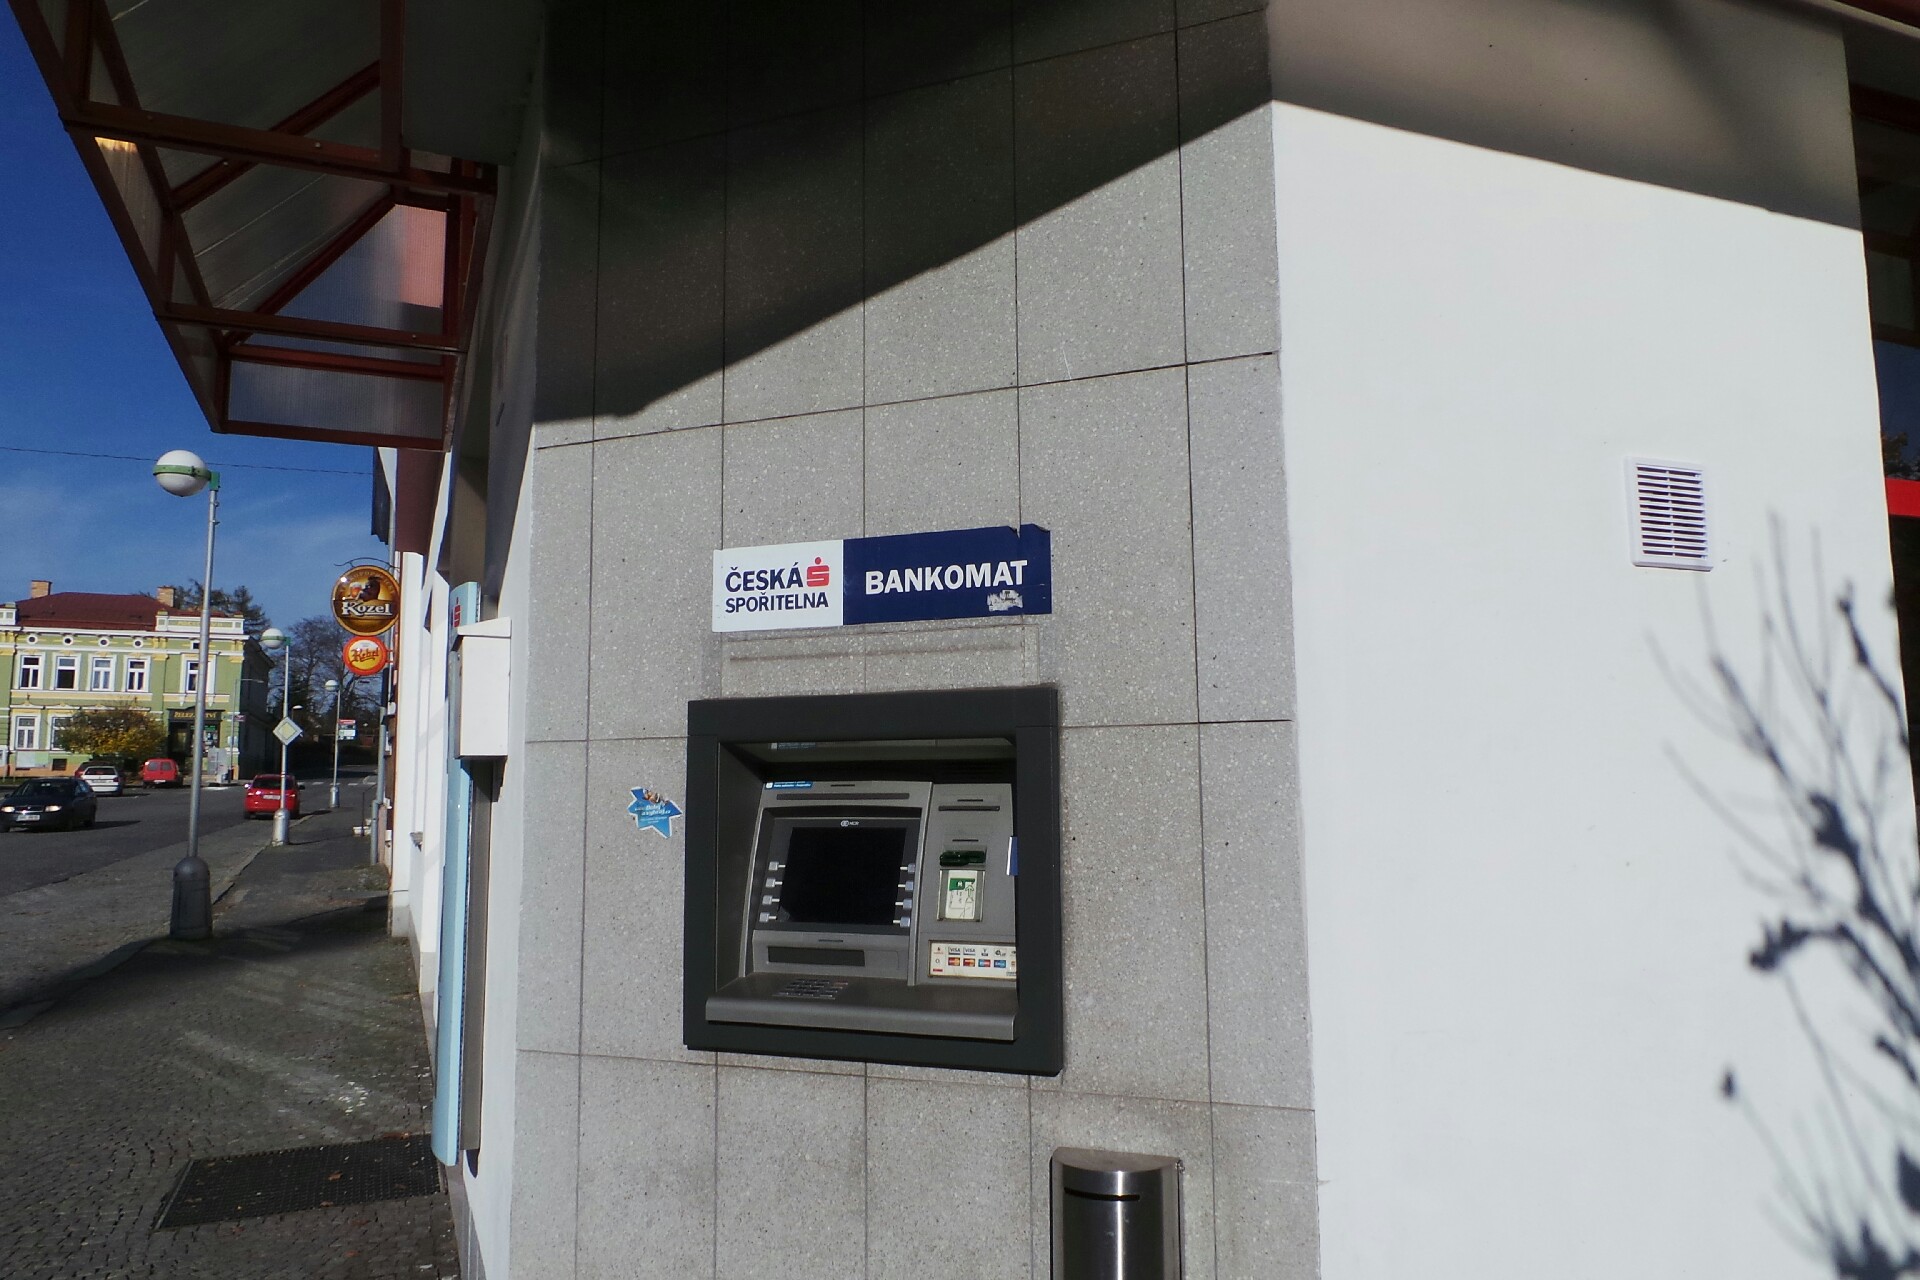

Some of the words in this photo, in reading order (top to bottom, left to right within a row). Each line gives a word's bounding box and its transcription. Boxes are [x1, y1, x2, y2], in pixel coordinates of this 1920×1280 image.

[725, 563, 803, 592] ČESKÁ
[866, 560, 1028, 595] BANKOMAT
[341, 601, 392, 616] Kozel
[725, 592, 829, 613] SPOŘITELNA
